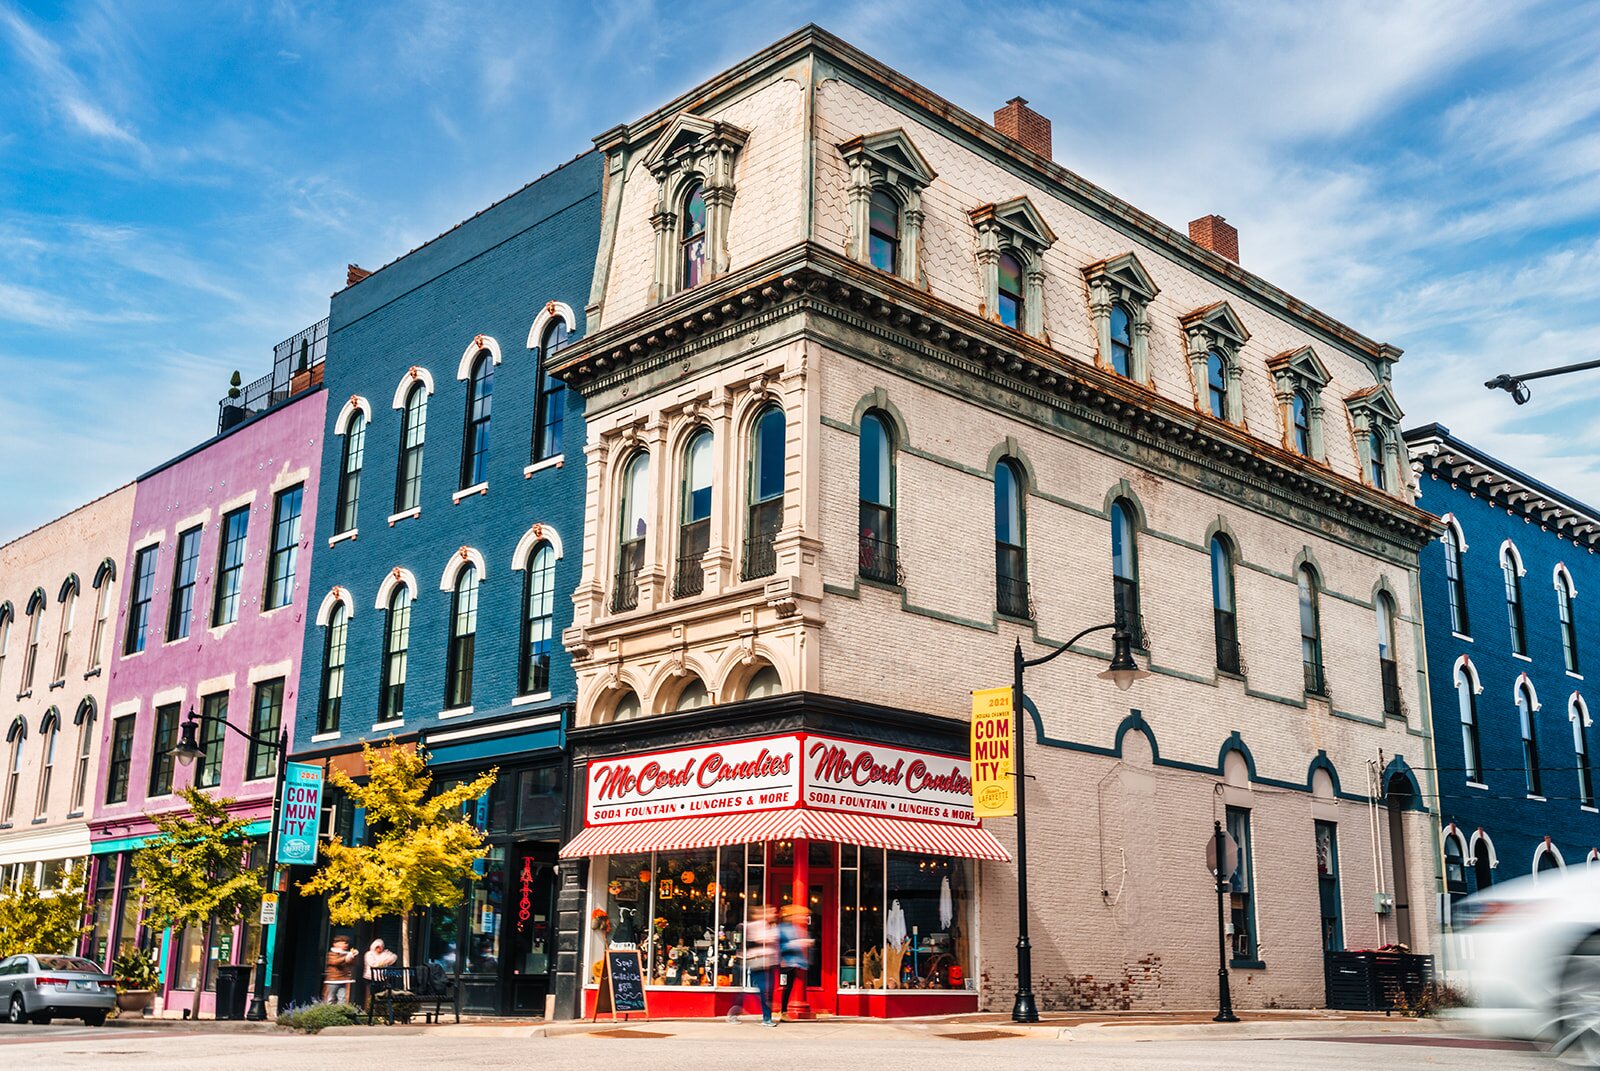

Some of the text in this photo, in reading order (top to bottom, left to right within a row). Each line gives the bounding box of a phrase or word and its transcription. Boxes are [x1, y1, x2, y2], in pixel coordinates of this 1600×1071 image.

[989, 698, 1009, 707] 2021
[975, 719, 1009, 740] COM
[975, 740, 1009, 760] MUN
[808, 741, 904, 784] McCord
[975, 762, 999, 781] ITY
[594, 748, 793, 800] McCord Candies
[288, 787, 317, 804] COM
[809, 792, 836, 804] SODA
[840, 795, 887, 810] FOUNTAIN
[898, 803, 940, 817] LUNCHES
[942, 808, 949, 818] &
[286, 804, 316, 820] MUN
[594, 792, 789, 820] SODA FOUNTAIN LUNCHES & MORE
[284, 820, 306, 836] ITY
[519, 857, 535, 920] TATTOO
